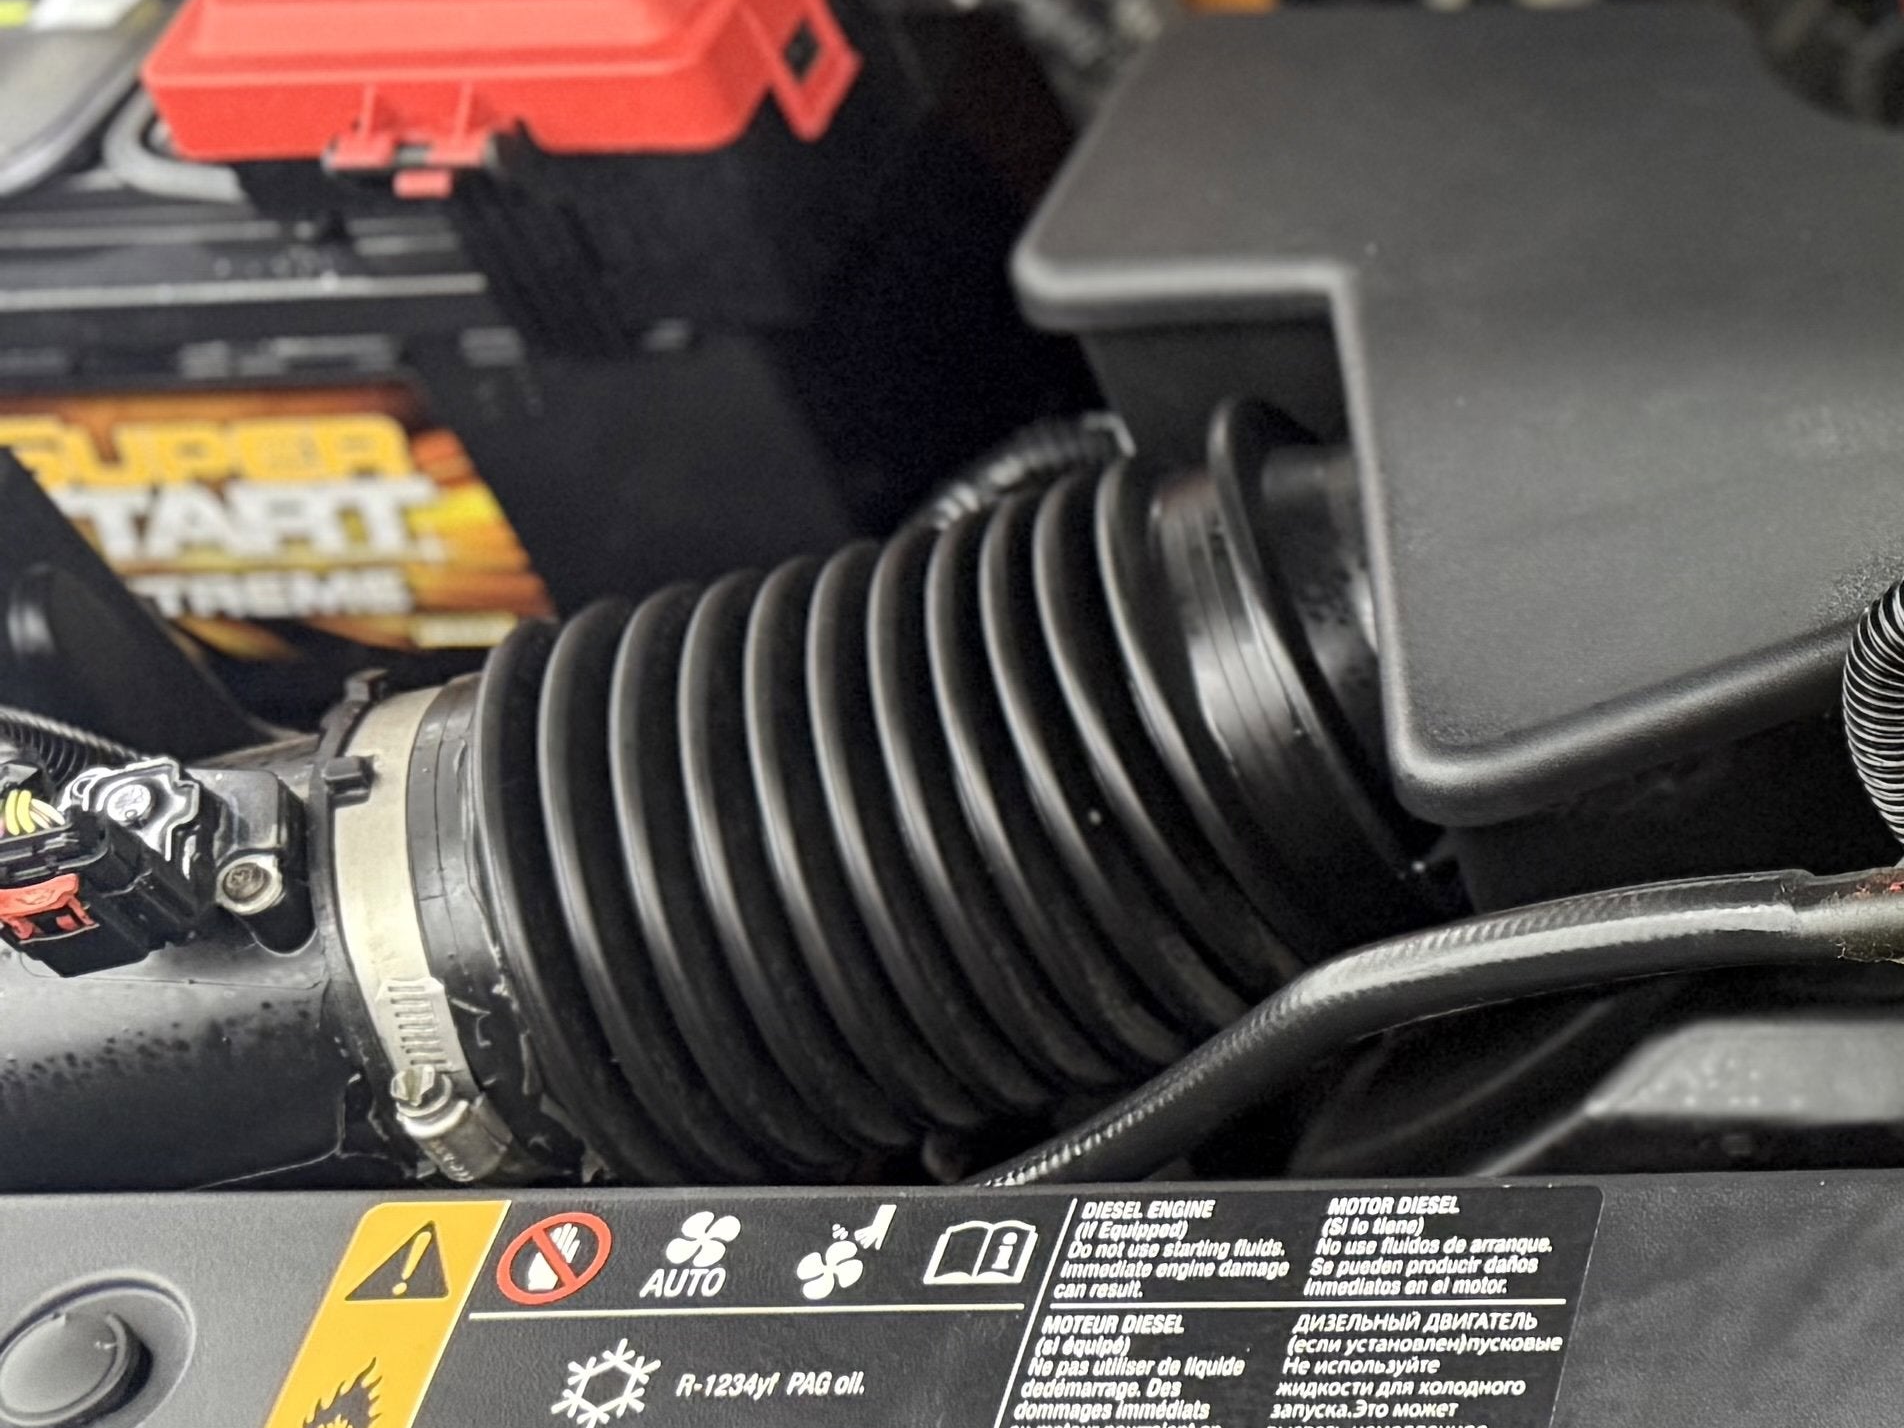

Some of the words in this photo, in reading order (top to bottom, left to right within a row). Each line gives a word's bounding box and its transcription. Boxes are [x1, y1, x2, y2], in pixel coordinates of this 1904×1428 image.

[58, 477, 432, 559] TART
[1081, 1201, 1142, 1219] DIESEL
[1147, 1199, 1216, 1219] ENGINE
[1327, 1197, 1395, 1215] MOTOR
[1397, 1196, 1460, 1214] DIESEL
[1100, 1221, 1188, 1242] Equipped)
[1321, 1218, 1348, 1238] (Si
[1372, 1217, 1425, 1236] tiene)
[1067, 1242, 1092, 1258] Do
[1095, 1241, 1125, 1258] not
[1127, 1243, 1160, 1258] use
[1163, 1240, 1230, 1259] starting
[1233, 1239, 1286, 1257] fluids.
[1315, 1238, 1342, 1255] No
[1344, 1240, 1377, 1255] use
[1381, 1236, 1440, 1254] fluidos
[1442, 1236, 1467, 1254] de
[1469, 1237, 1553, 1256] arranque.
[1060, 1261, 1152, 1278] Immediate
[1155, 1261, 1215, 1280] engine
[1218, 1259, 1290, 1280] damage
[1309, 1258, 1334, 1276] Se
[1336, 1258, 1403, 1278] pueden
[1404, 1257, 1482, 1277] producir
[1483, 1256, 1539, 1273] daños
[639, 1267, 727, 1298] AUTO
[1053, 1284, 1085, 1298] can
[1089, 1280, 1144, 1298] result.
[1404, 1279, 1428, 1295] en
[1430, 1277, 1450, 1294] el
[1452, 1277, 1508, 1295] motor.
[1041, 1315, 1120, 1334] MOTEUR
[1121, 1314, 1185, 1334] DIESEL
[1292, 1311, 1421, 1335] ДИЗЕЛЬНЫЙ
[1422, 1312, 1538, 1333] ДВИГАТЕЛЬ
[1062, 1336, 1131, 1358] équipé)
[1287, 1336, 1342, 1356] (если
[1027, 1359, 1054, 1376] Ne
[1055, 1360, 1090, 1378] pas
[1092, 1357, 1155, 1376] utiliser
[1157, 1358, 1182, 1376] de
[1184, 1357, 1245, 1379] liquide
[1282, 1357, 1310, 1374] Не
[1313, 1356, 1441, 1378] используйте
[676, 1372, 781, 1401] R-1234yf
[787, 1371, 832, 1396] PAG
[1021, 1378, 1141, 1400] dedémarrage.
[1146, 1378, 1182, 1397] Des
[1275, 1381, 1373, 1398] жидкости
[1376, 1381, 1414, 1397] для
[1418, 1380, 1526, 1397] холодного
[1013, 1400, 1112, 1422] dommages
[1392, 1403, 1459, 1419] может
